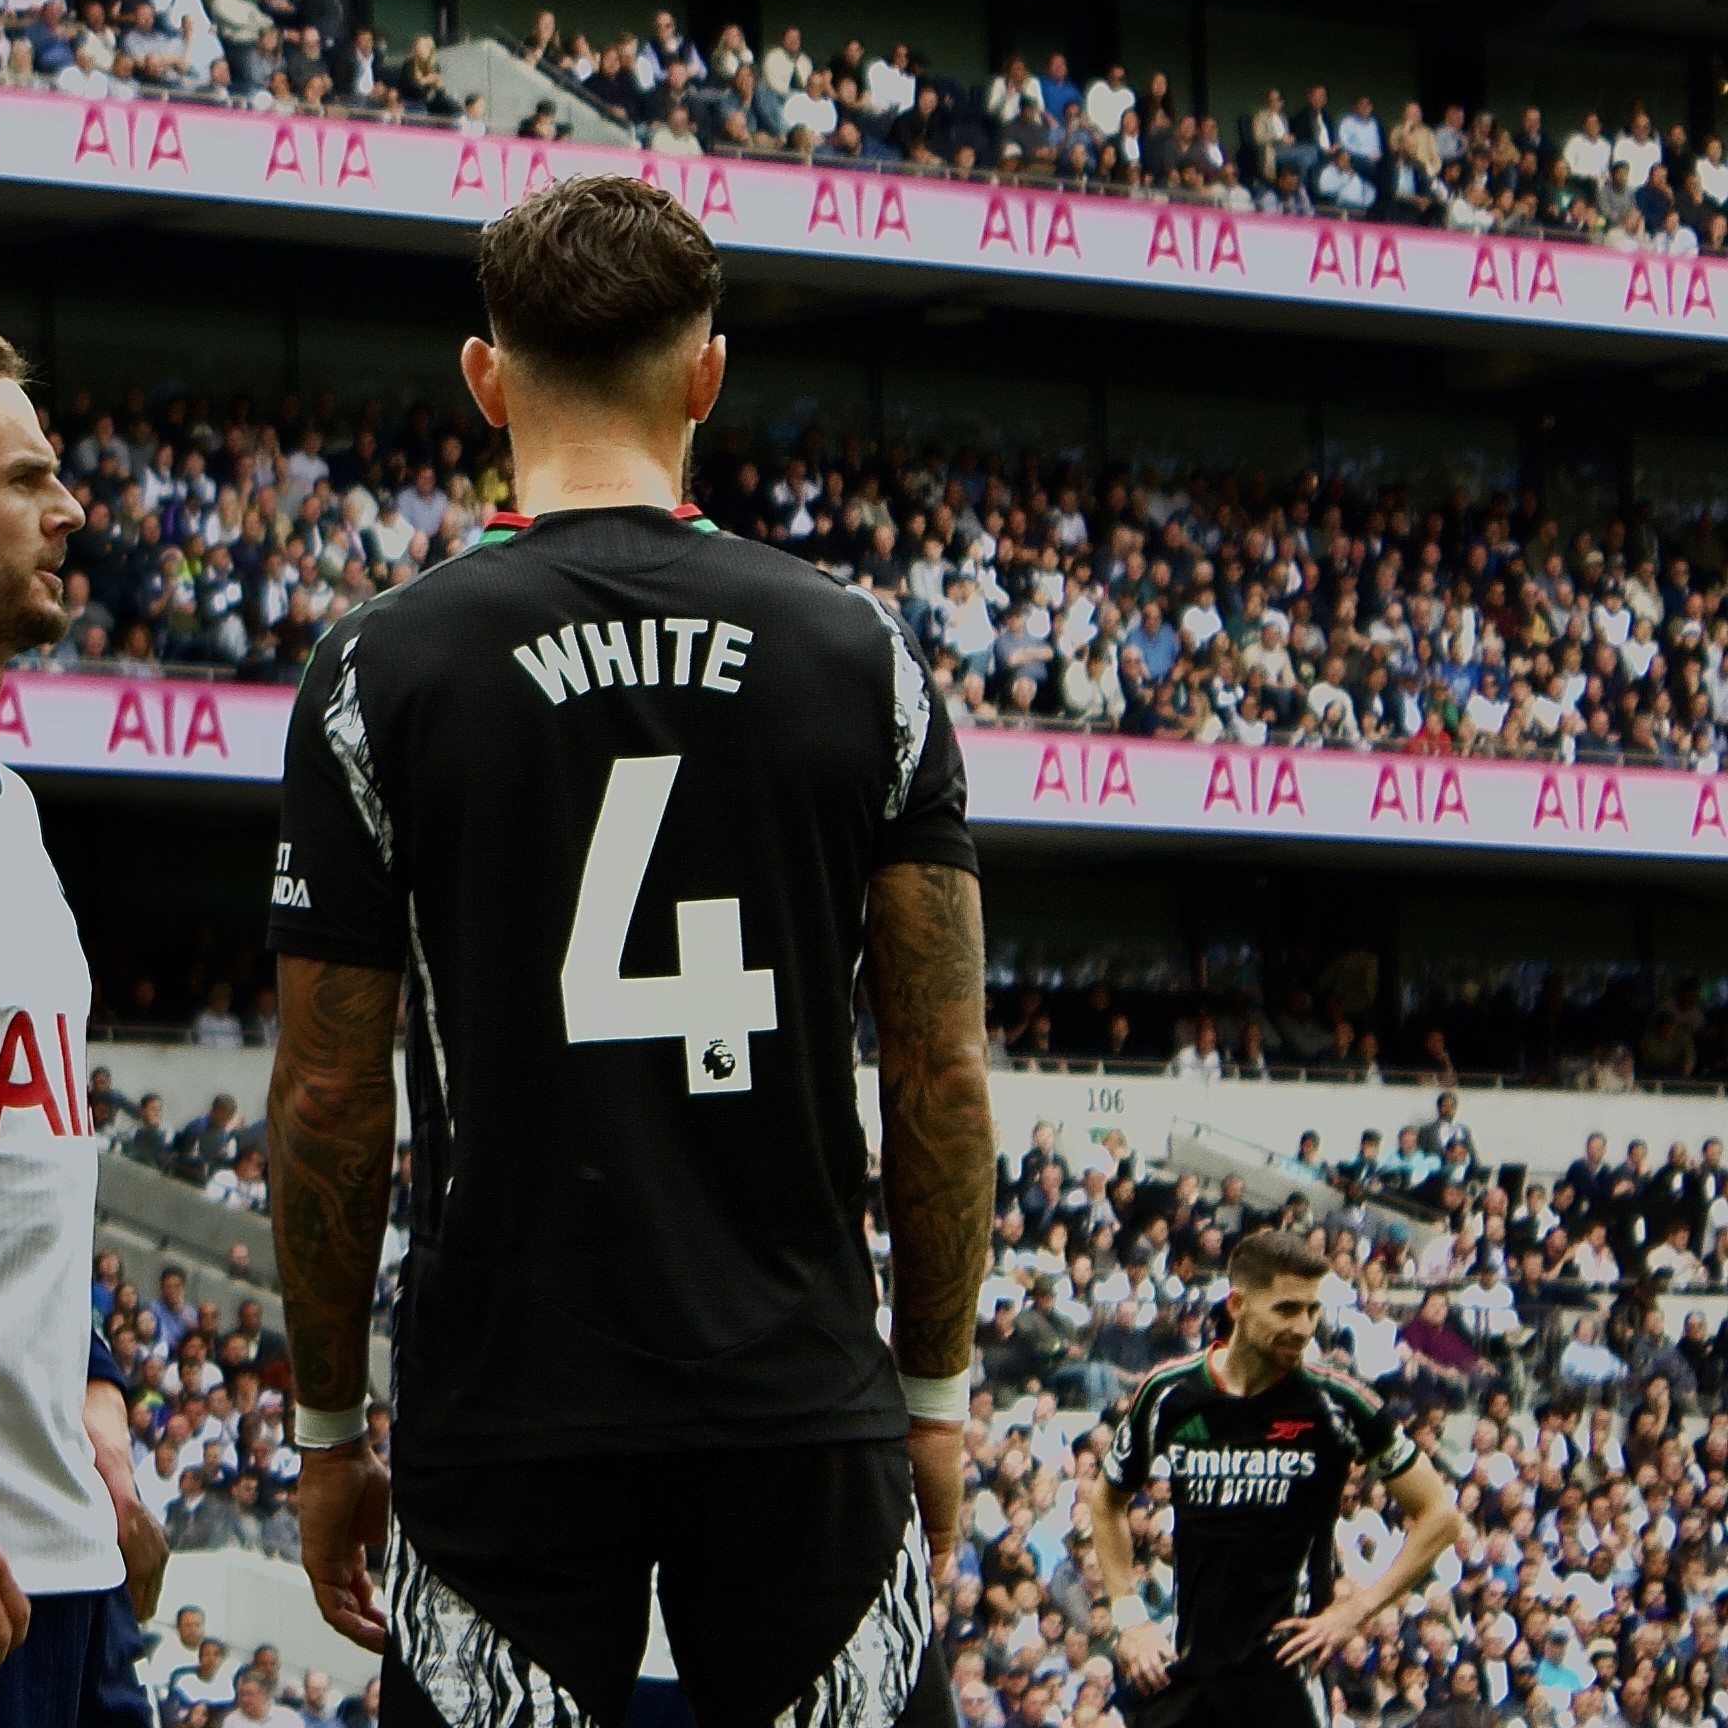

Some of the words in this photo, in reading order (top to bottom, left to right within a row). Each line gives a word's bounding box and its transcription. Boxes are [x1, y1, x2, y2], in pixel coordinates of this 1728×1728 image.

[75, 103, 189, 176] AIA
[264, 122, 377, 189] AIA
[808, 178, 912, 242] AIA
[980, 193, 1083, 261] AIA
[1147, 210, 1246, 276] AIA
[1310, 231, 1406, 293] AIA
[1469, 246, 1563, 306] AIA
[1625, 261, 1717, 321] AIA
[513, 617, 753, 706] WHITE
[107, 688, 230, 759] AIA
[1034, 743, 1137, 807] AIA
[1203, 754, 1304, 816] AIA
[1370, 764, 1469, 824] AIA
[1533, 775, 1629, 833] AIA
[561, 756, 776, 1094] 4
[1086, 1086, 1125, 1114] 106
[1169, 1443, 1316, 1478] Emirates
[1219, 1478, 1291, 1507] BETTER
